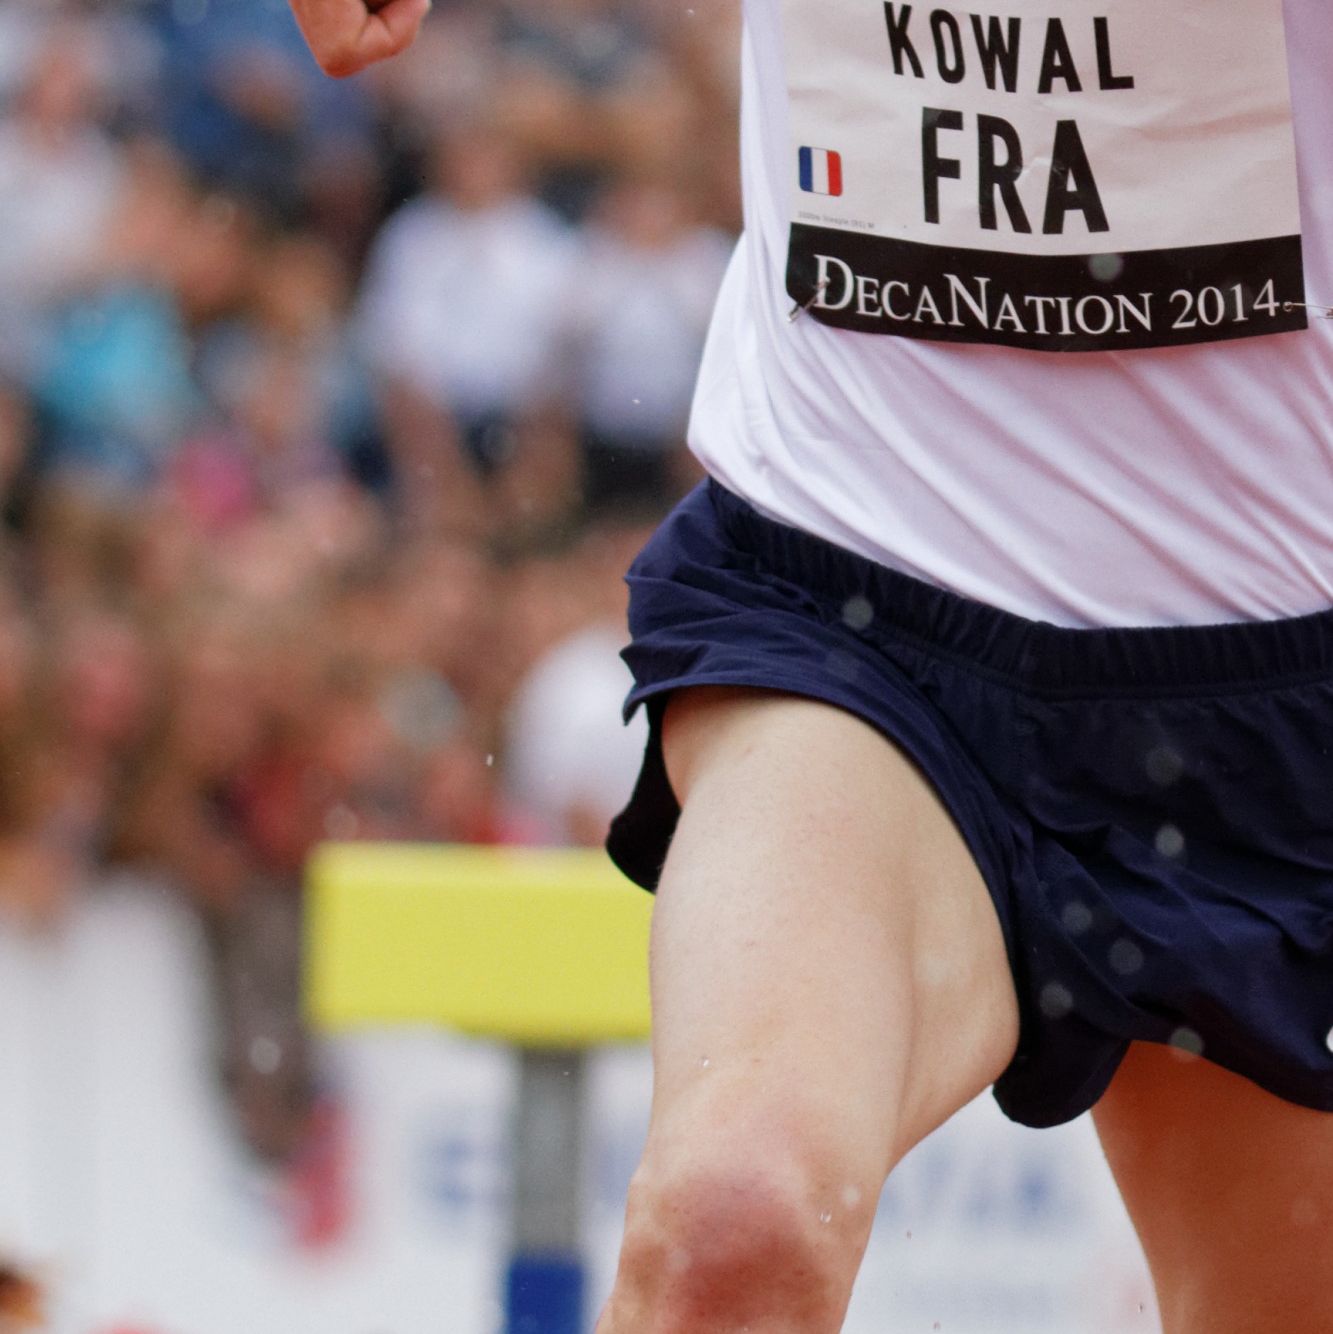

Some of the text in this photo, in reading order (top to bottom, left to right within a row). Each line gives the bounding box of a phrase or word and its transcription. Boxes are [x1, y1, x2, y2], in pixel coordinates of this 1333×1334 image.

[883, 1, 1134, 94] KOWAL
[922, 107, 1110, 235] FRA
[1170, 279, 1280, 329] 2014
